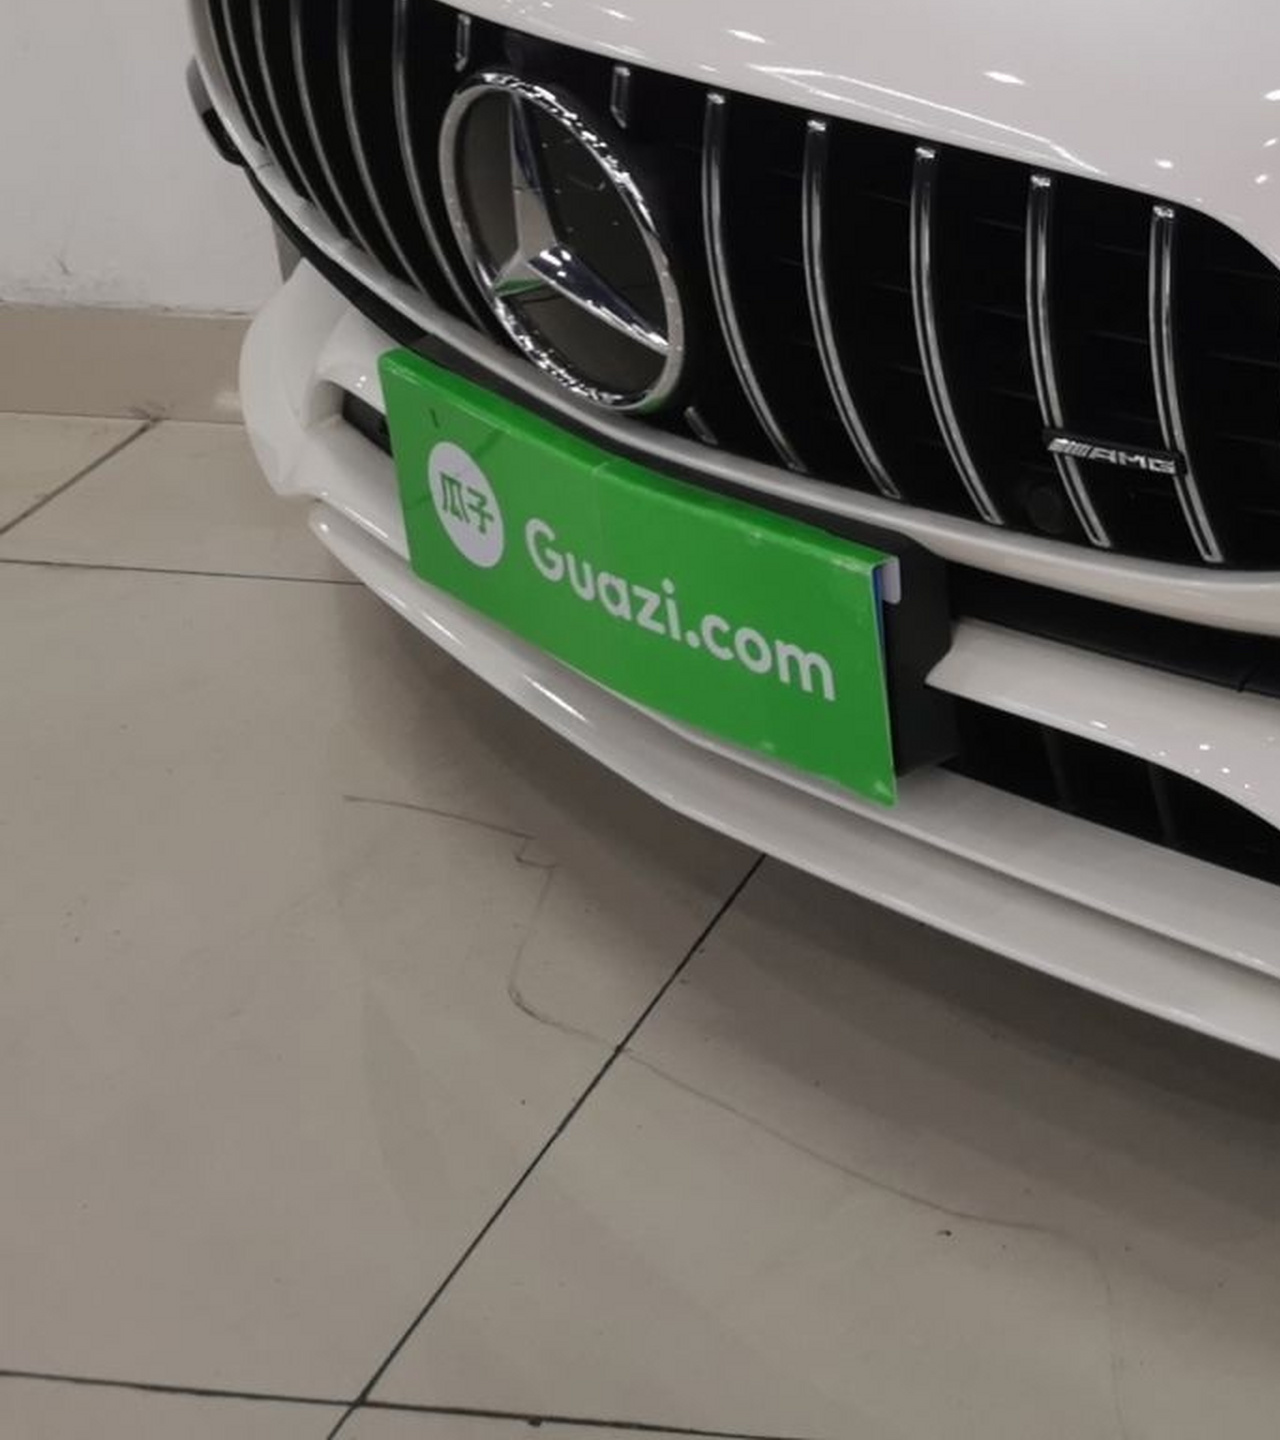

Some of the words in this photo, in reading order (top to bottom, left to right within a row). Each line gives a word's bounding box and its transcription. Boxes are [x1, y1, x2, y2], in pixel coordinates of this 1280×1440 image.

[1085, 445, 1177, 475] AMG
[440, 471, 495, 535] 瓜子
[525, 518, 836, 701] Guazi.com
